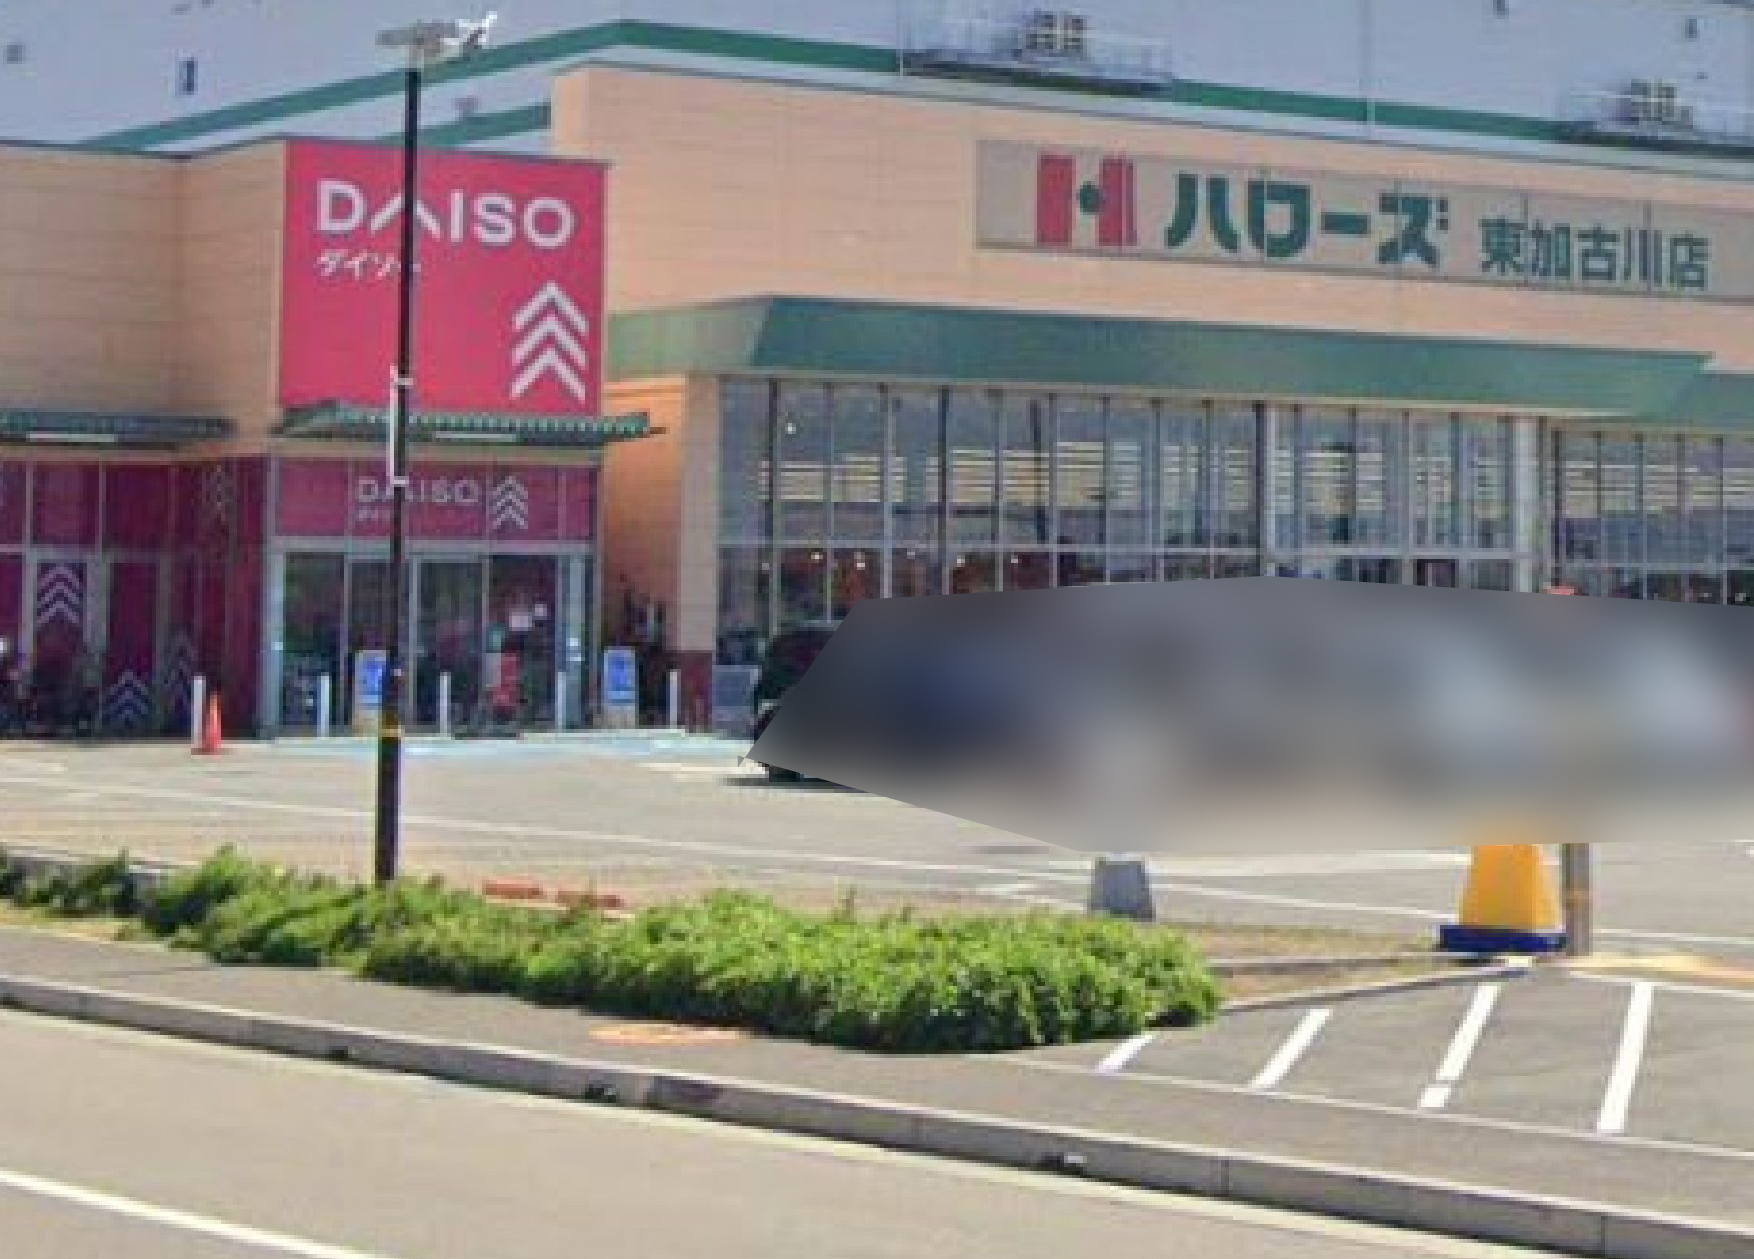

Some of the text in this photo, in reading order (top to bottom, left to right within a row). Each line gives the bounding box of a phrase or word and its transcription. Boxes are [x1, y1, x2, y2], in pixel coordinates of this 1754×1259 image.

[316, 178, 577, 250] DAISO
[1163, 172, 1450, 268] ハローズ
[1478, 215, 1711, 291] 東加古川店
